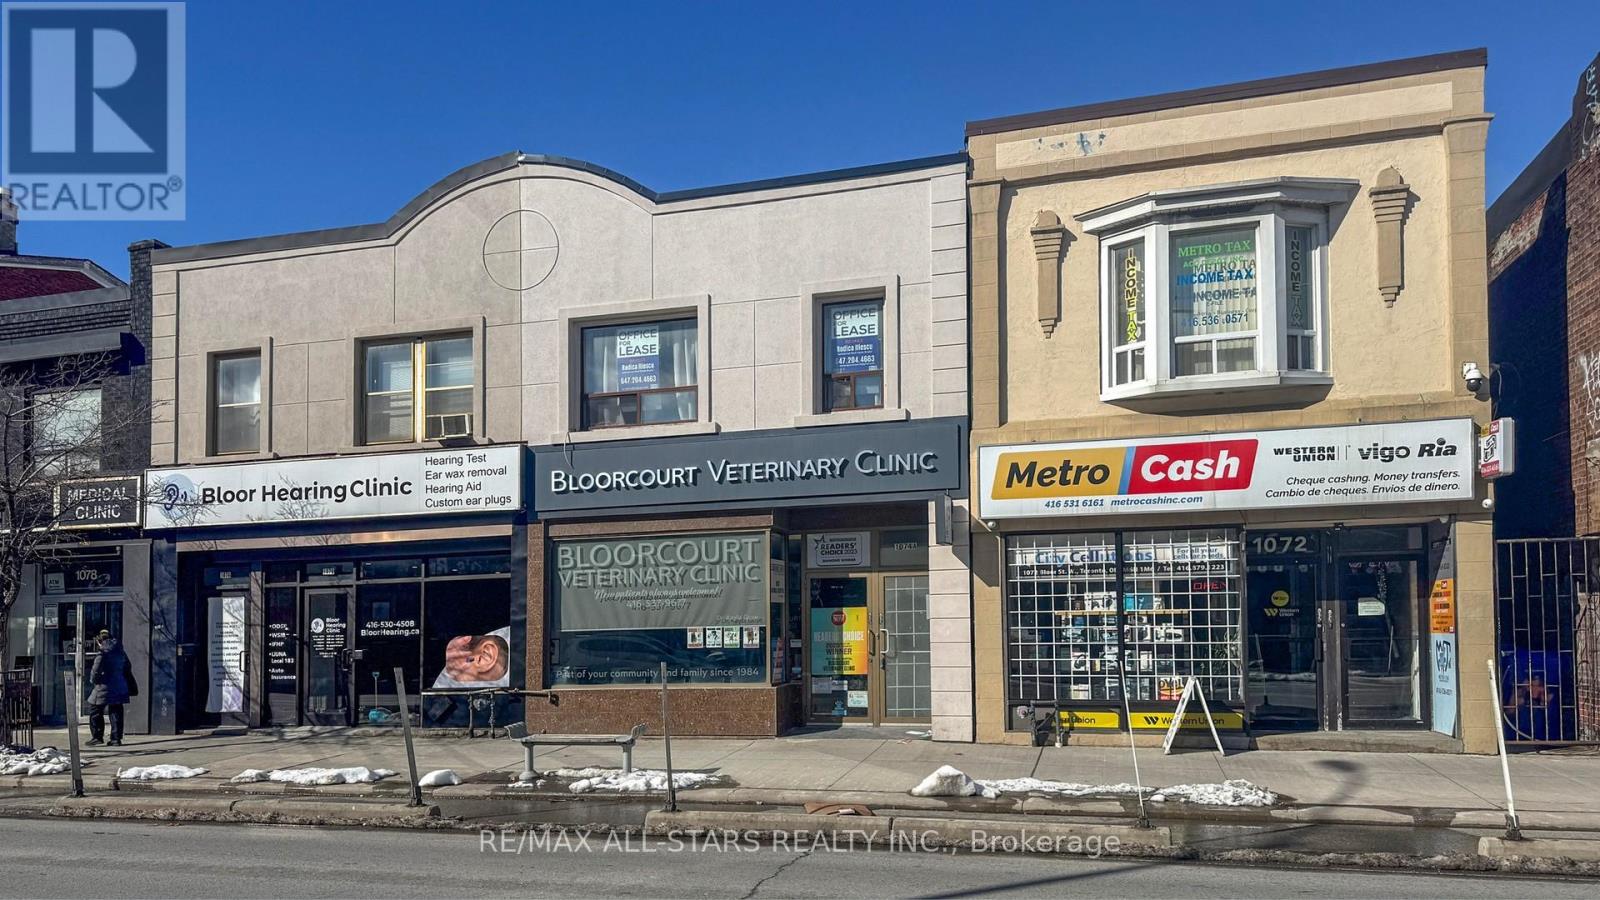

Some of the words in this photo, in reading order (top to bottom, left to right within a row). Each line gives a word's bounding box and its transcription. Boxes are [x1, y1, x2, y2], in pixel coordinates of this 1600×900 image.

[1178, 243, 1221, 258] METRO
[1225, 240, 1251, 252] TAX
[1291, 231, 1301, 292] INCOME
[1126, 249, 1136, 308] INCOME
[1177, 271, 1225, 286] INCOME
[1228, 268, 1253, 281] TAX
[833, 308, 876, 320] OFFICE
[834, 324, 876, 337] LEASE
[1127, 310, 1137, 342] TAX
[619, 329, 656, 340] OFFICE
[619, 344, 656, 356] LEASE
[1273, 446, 1335, 456] WESTERN
[1293, 454, 1336, 462] UNION
[1358, 443, 1410, 463] vigo
[1417, 437, 1458, 458] Ria
[425, 455, 463, 467] Hearing
[466, 453, 487, 464] Test
[425, 470, 443, 480] Ear
[445, 470, 465, 479] wax
[468, 465, 507, 477] removal
[551, 465, 698, 492] BLOORCOURT
[707, 457, 845, 484] VETERINARY
[855, 450, 937, 474] CLINIC
[1005, 459, 1111, 489] Metro
[1140, 450, 1241, 482] Cash
[1286, 477, 1325, 487] Cheque
[1328, 474, 1371, 485] cashing.
[1374, 472, 1409, 482] Money
[1411, 469, 1460, 480] transfers.
[68, 487, 130, 503] MEDICAL
[202, 486, 257, 504] Bloor
[262, 481, 347, 503] Hearing
[350, 476, 413, 498] Clinic
[425, 483, 463, 494] Hearing
[466, 481, 482, 491] Aid
[1265, 488, 1305, 498] Cambio
[1308, 487, 1321, 496] de
[1324, 486, 1369, 497] cheques.
[1372, 484, 1405, 494] Envios
[1409, 483, 1421, 492] de
[1425, 481, 1460, 492] dinero.
[425, 498, 463, 508] Custom
[466, 497, 482, 505] ear
[485, 495, 512, 506] plugs
[1044, 501, 1061, 509] 416
[1063, 500, 1080, 508] 531
[1081, 499, 1104, 507] 6161
[1110, 495, 1203, 507] metrocashinc.com
[75, 504, 121, 520] CLINIC
[1252, 536, 1307, 555] 1072
[558, 538, 761, 571] BLOORCOURT
[76, 569, 98, 581] 1078
[559, 567, 690, 590] VETERINARY
[690, 563, 762, 584] CLINIC
[361, 628, 420, 637] BloorHearing.ca
[576, 669, 587, 678] of
[588, 670, 607, 680] your
[610, 668, 659, 680] community
[665, 668, 679, 677] nd
[680, 667, 708, 679] family
[710, 667, 734, 677] since
[736, 667, 759, 677] 1984
[1161, 716, 1198, 725] Weern
